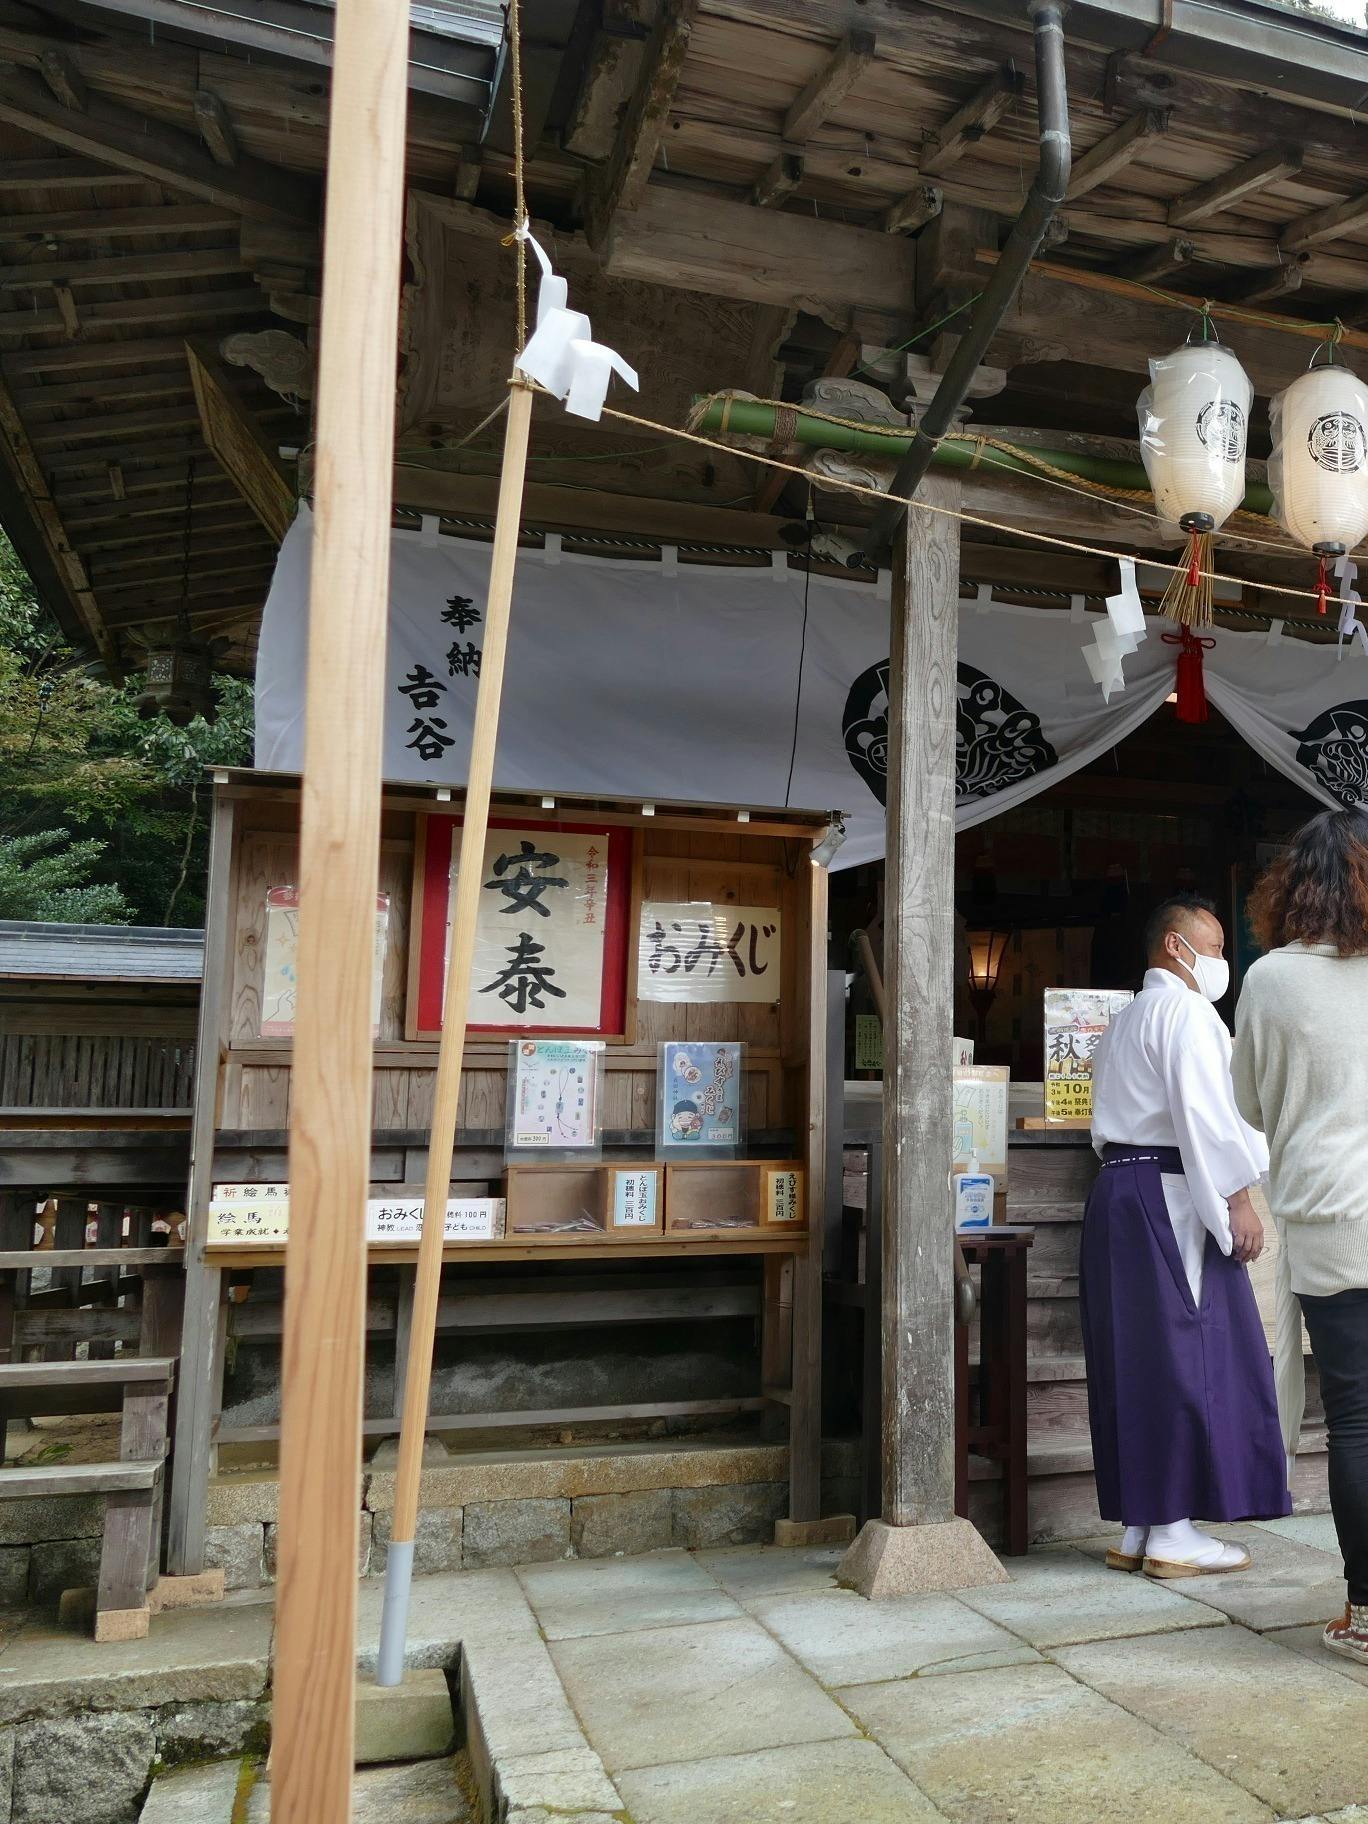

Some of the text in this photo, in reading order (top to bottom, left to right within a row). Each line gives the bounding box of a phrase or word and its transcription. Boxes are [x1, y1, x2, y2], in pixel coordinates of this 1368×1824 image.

[440, 595, 482, 679] 奉納
[583, 845, 600, 924] 令和三年辛丑
[477, 840, 570, 1014] 安泰
[646, 921, 777, 978] おみくじ
[1064, 1083, 1090, 1094] 10月
[217, 1210, 262, 1225] 絵馬
[637, 1175, 648, 1222] とんぼ玉おみくじ
